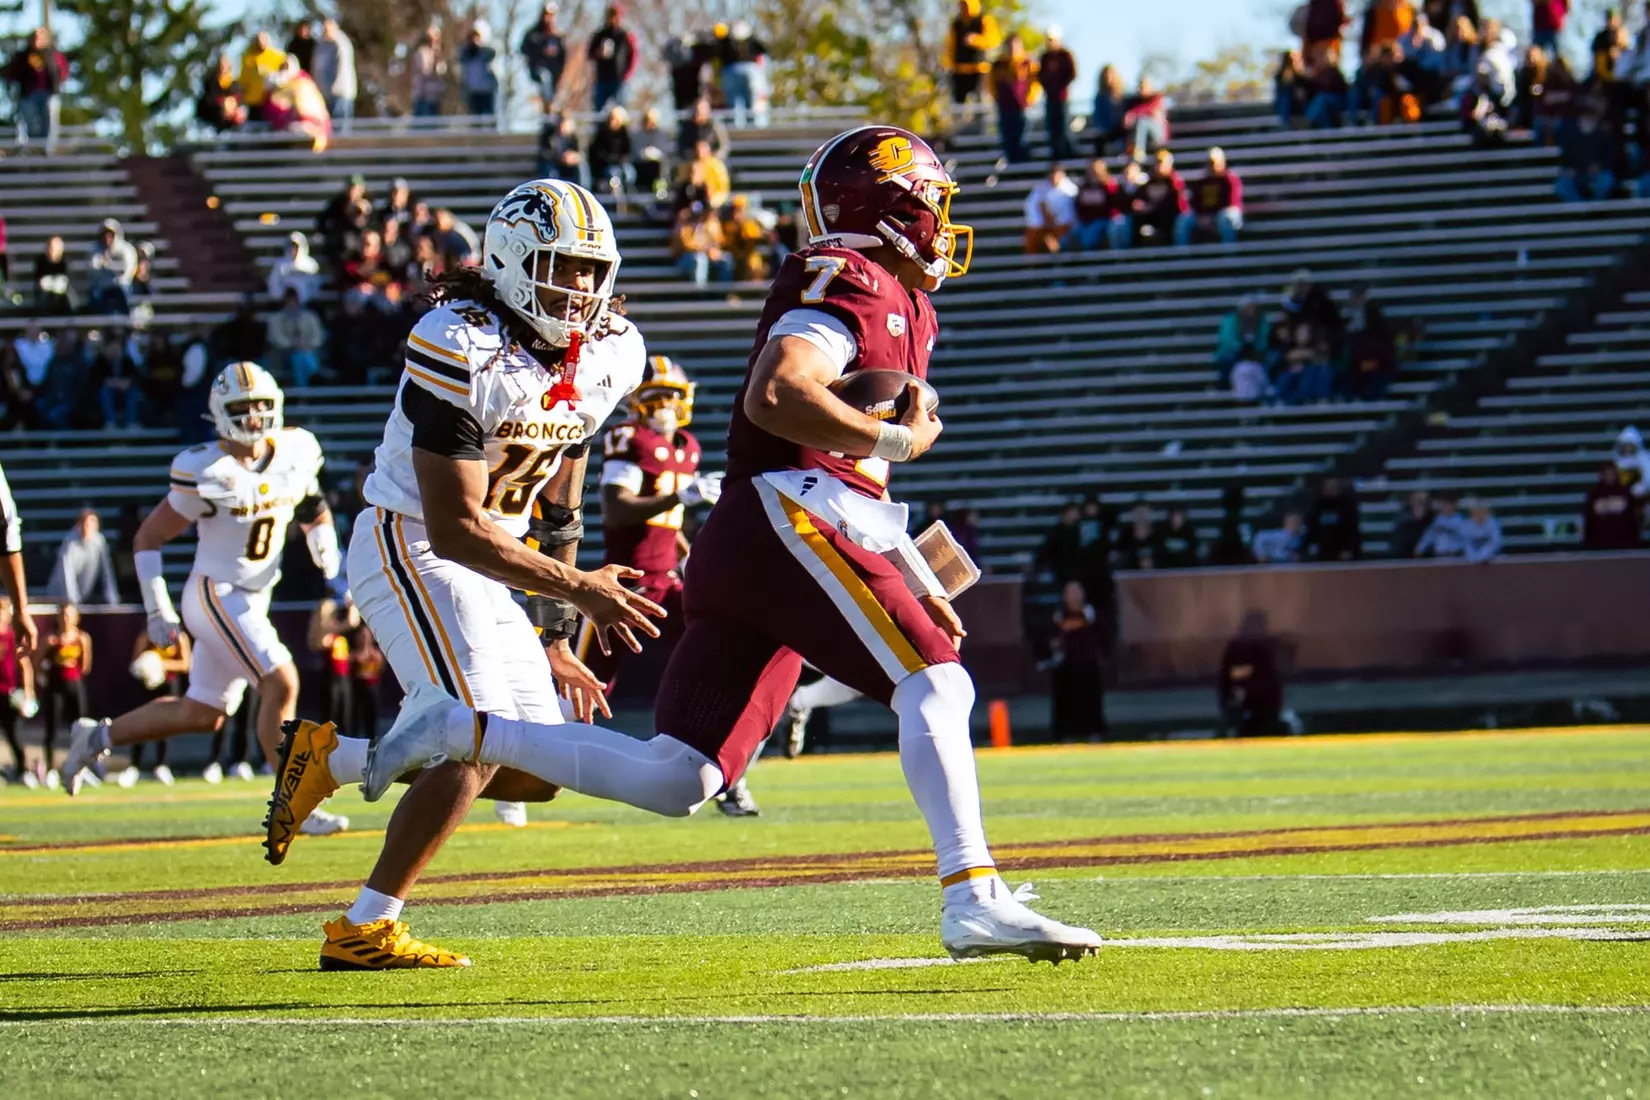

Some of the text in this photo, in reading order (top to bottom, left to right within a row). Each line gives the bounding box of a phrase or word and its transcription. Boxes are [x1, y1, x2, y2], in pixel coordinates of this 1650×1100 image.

[801, 256, 847, 304] 7
[603, 426, 636, 456] 17
[483, 443, 564, 516] 15
[246, 516, 275, 562] 0
